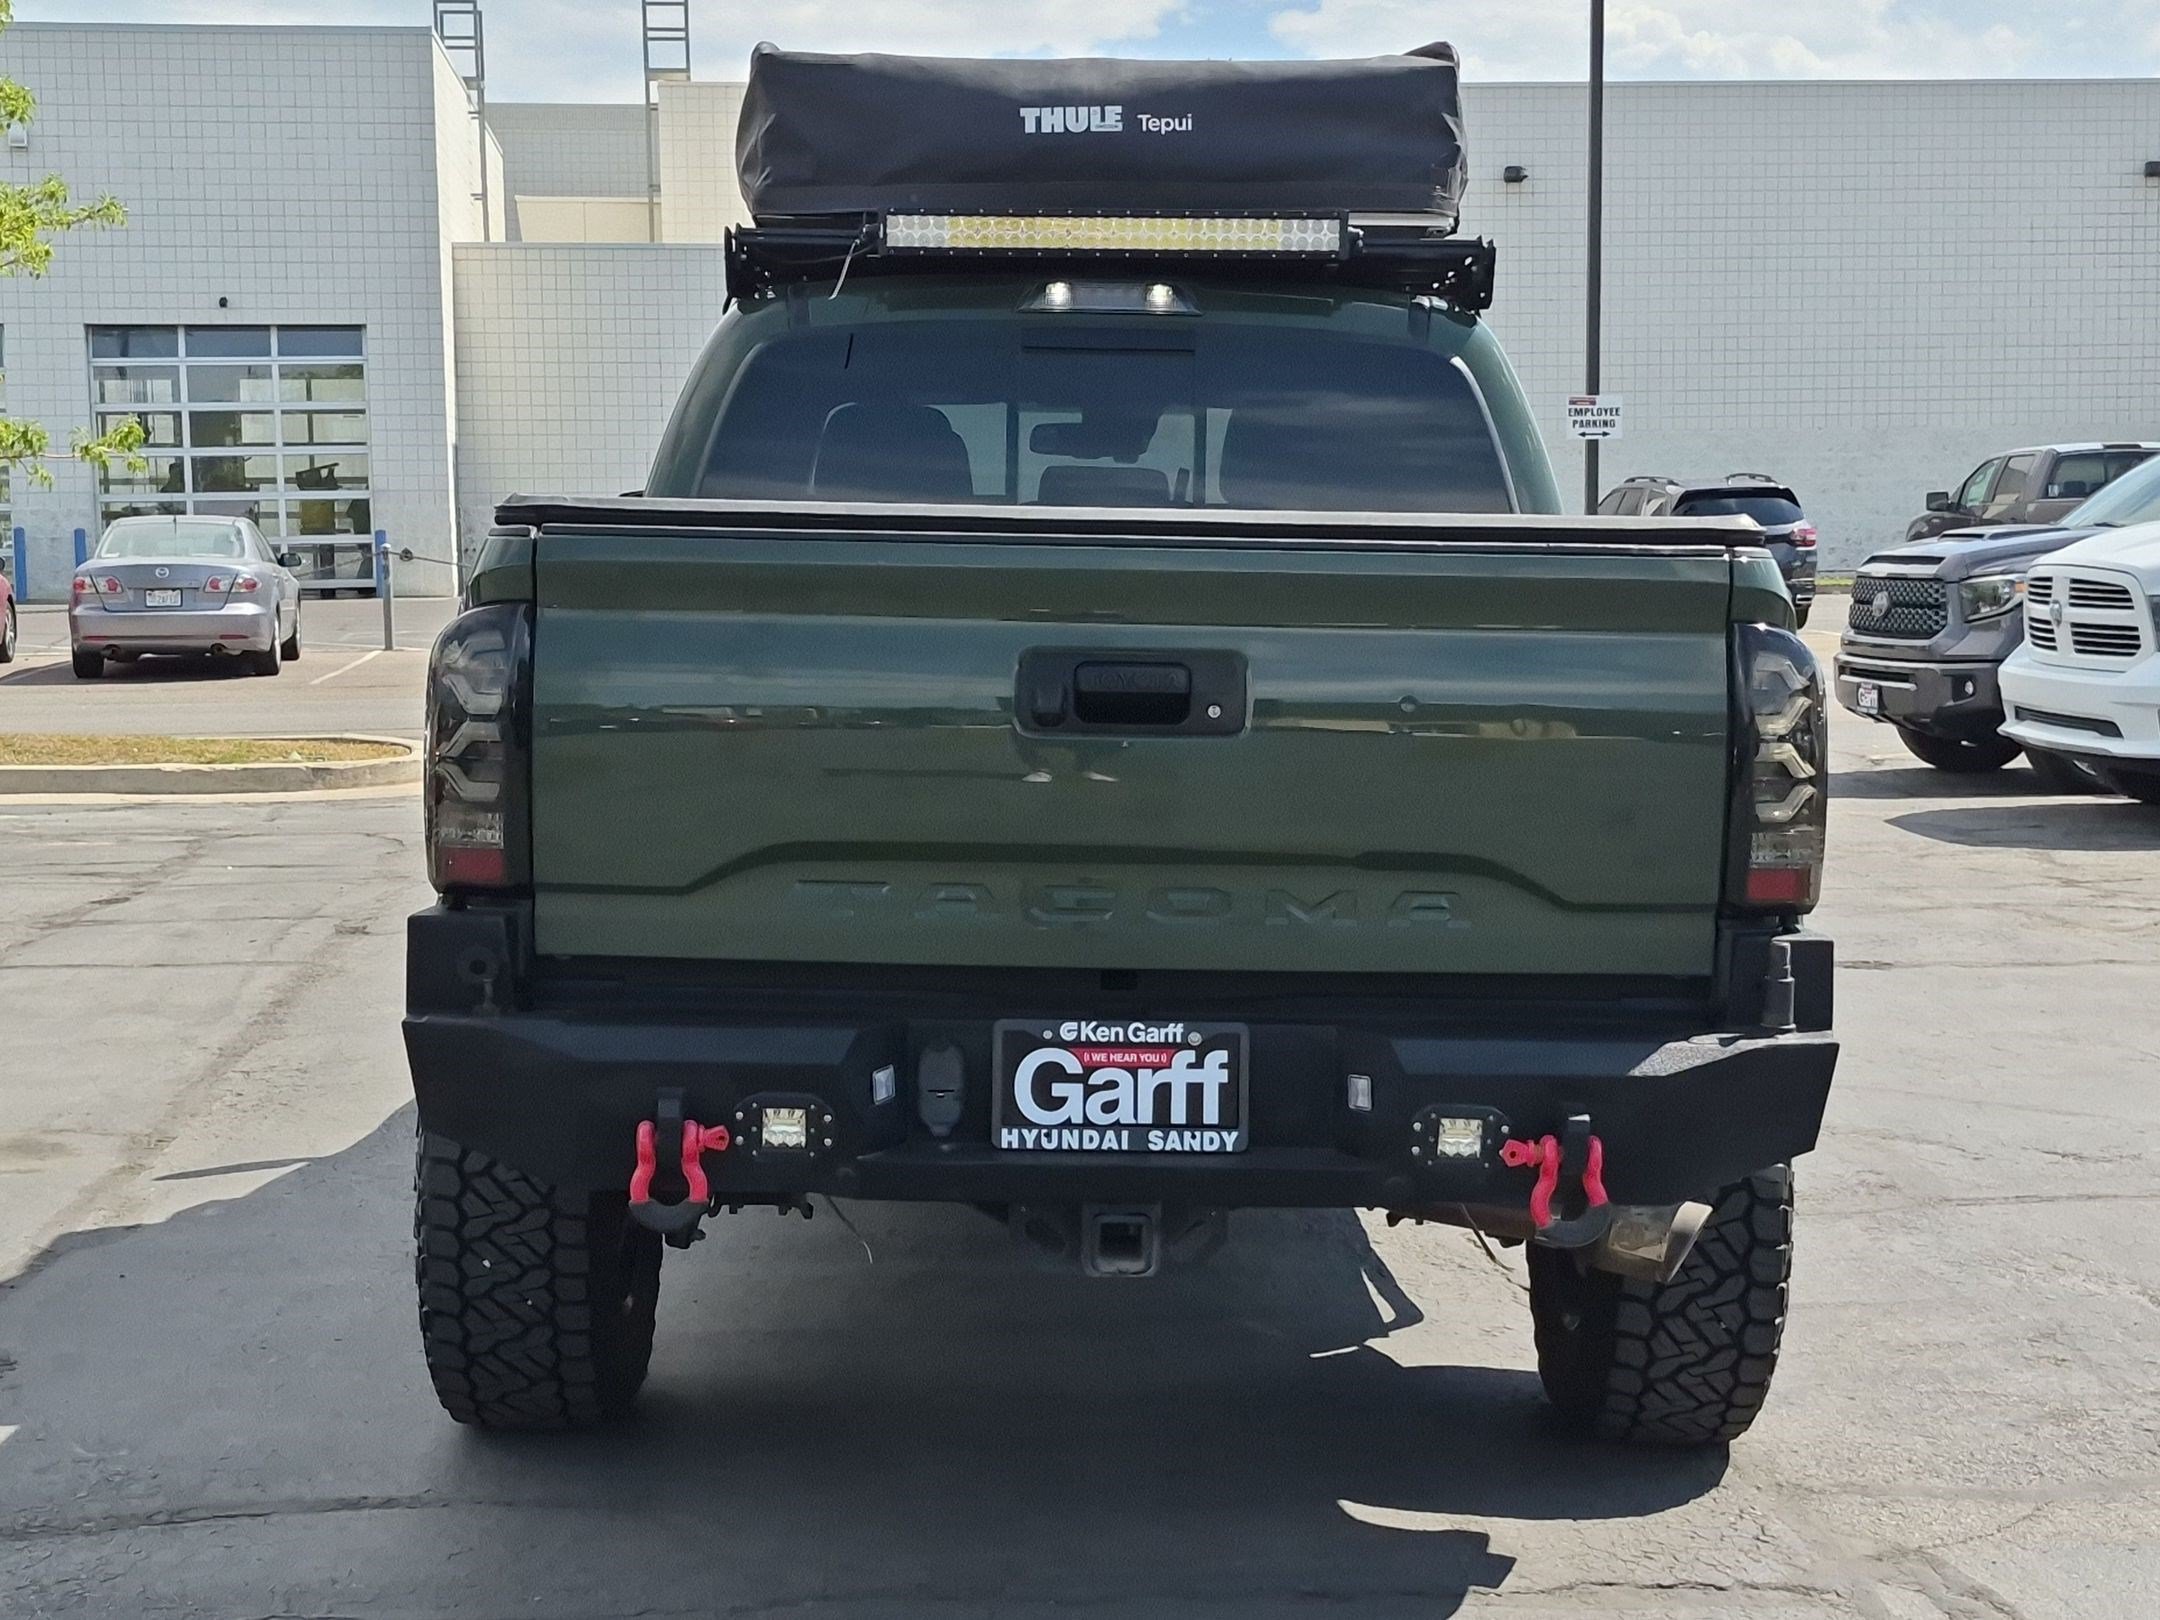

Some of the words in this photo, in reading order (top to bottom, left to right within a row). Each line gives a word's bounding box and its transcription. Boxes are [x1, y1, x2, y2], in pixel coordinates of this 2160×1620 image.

[1019, 105, 1123, 134] THULE
[1136, 114, 1193, 135] Tepui
[1568, 407, 1621, 417] EMPLOYEE
[1572, 419, 1616, 429] PARKING
[795, 878, 1473, 929] TACOMA
[1080, 1021, 1124, 1043] Ken
[1127, 1022, 1185, 1044] Garff
[1091, 1053, 1108, 1063] WE
[1109, 1053, 1137, 1063] HEAR
[1138, 1053, 1159, 1063] YOU
[1014, 1047, 1229, 1125] Garff
[1001, 1127, 1130, 1150] HYUNDAI
[1147, 1129, 1239, 1152] SANDY
